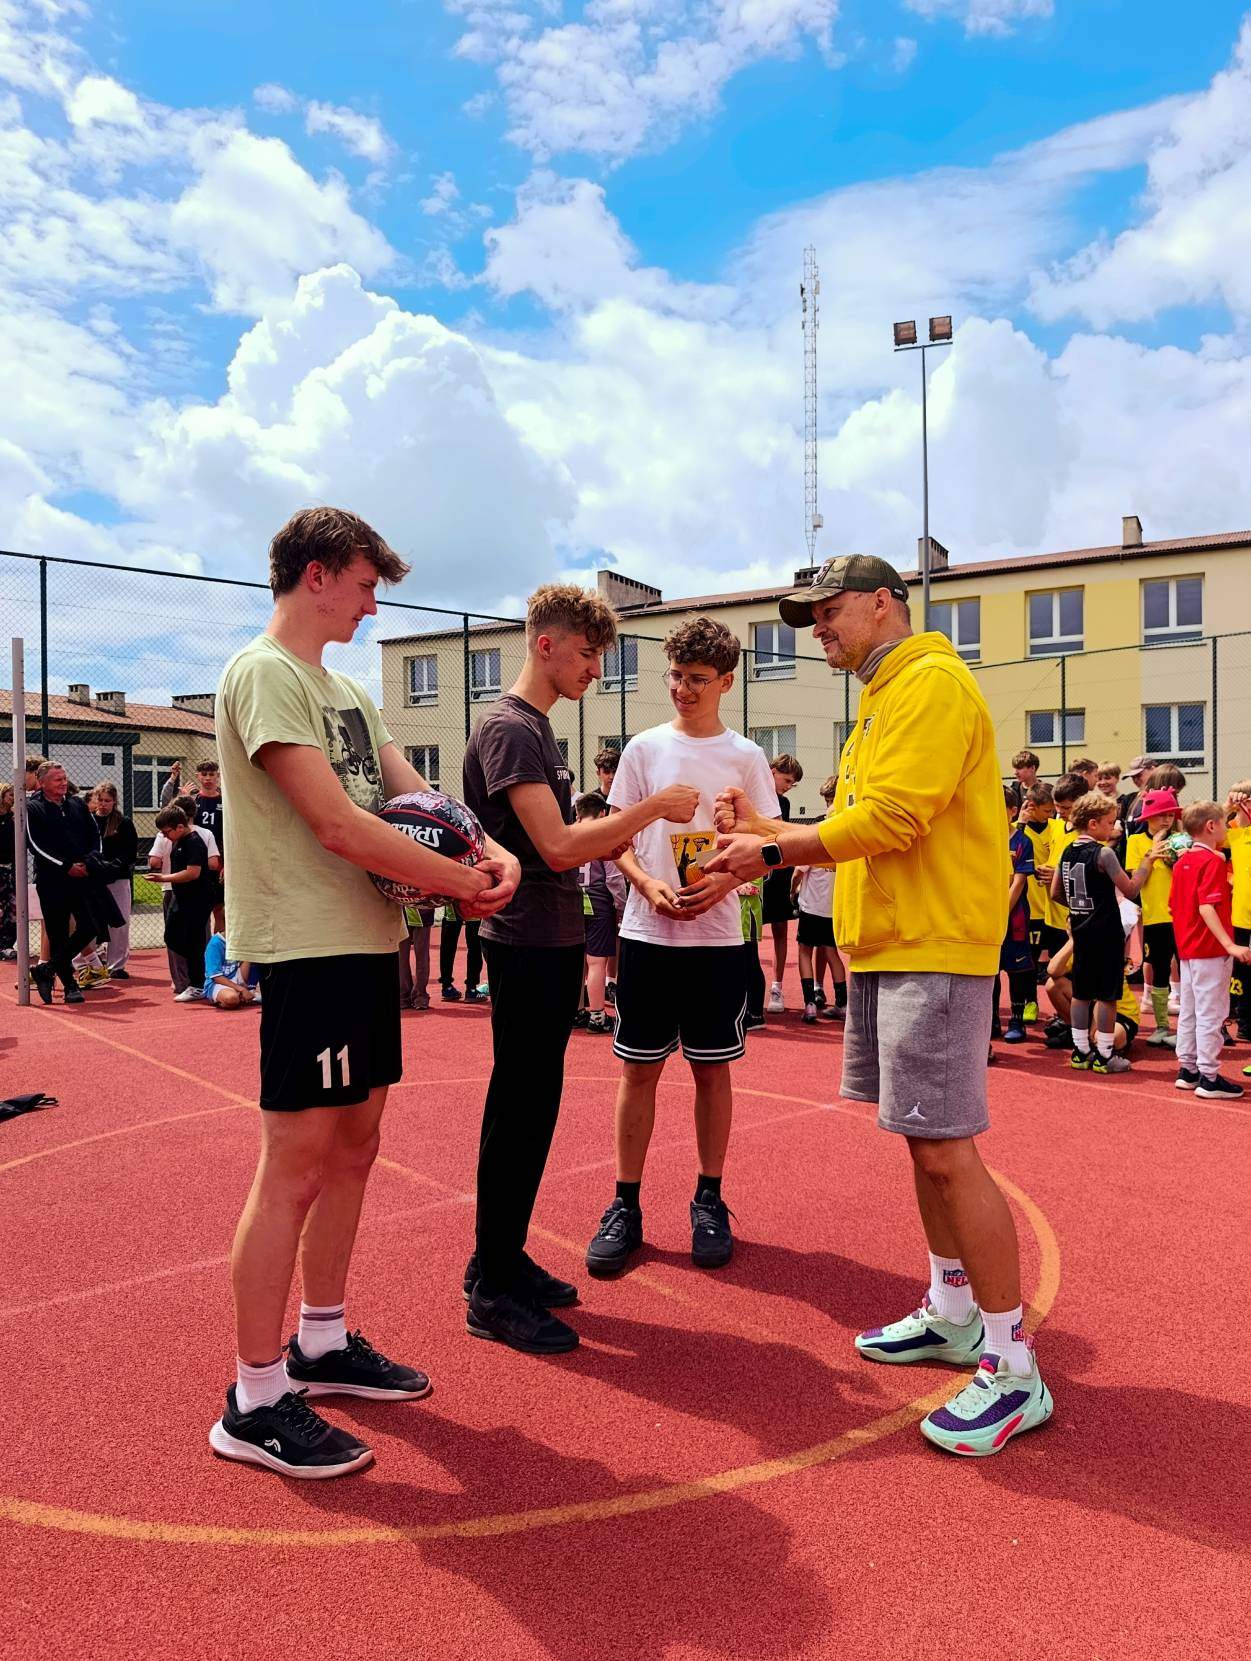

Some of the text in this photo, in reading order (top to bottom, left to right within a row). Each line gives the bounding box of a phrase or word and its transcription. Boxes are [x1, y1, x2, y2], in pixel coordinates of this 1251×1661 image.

[202, 811, 215, 825] 21
[1029, 930, 1041, 945] 17
[1229, 976, 1244, 996] 23
[316, 1044, 351, 1089] 11
